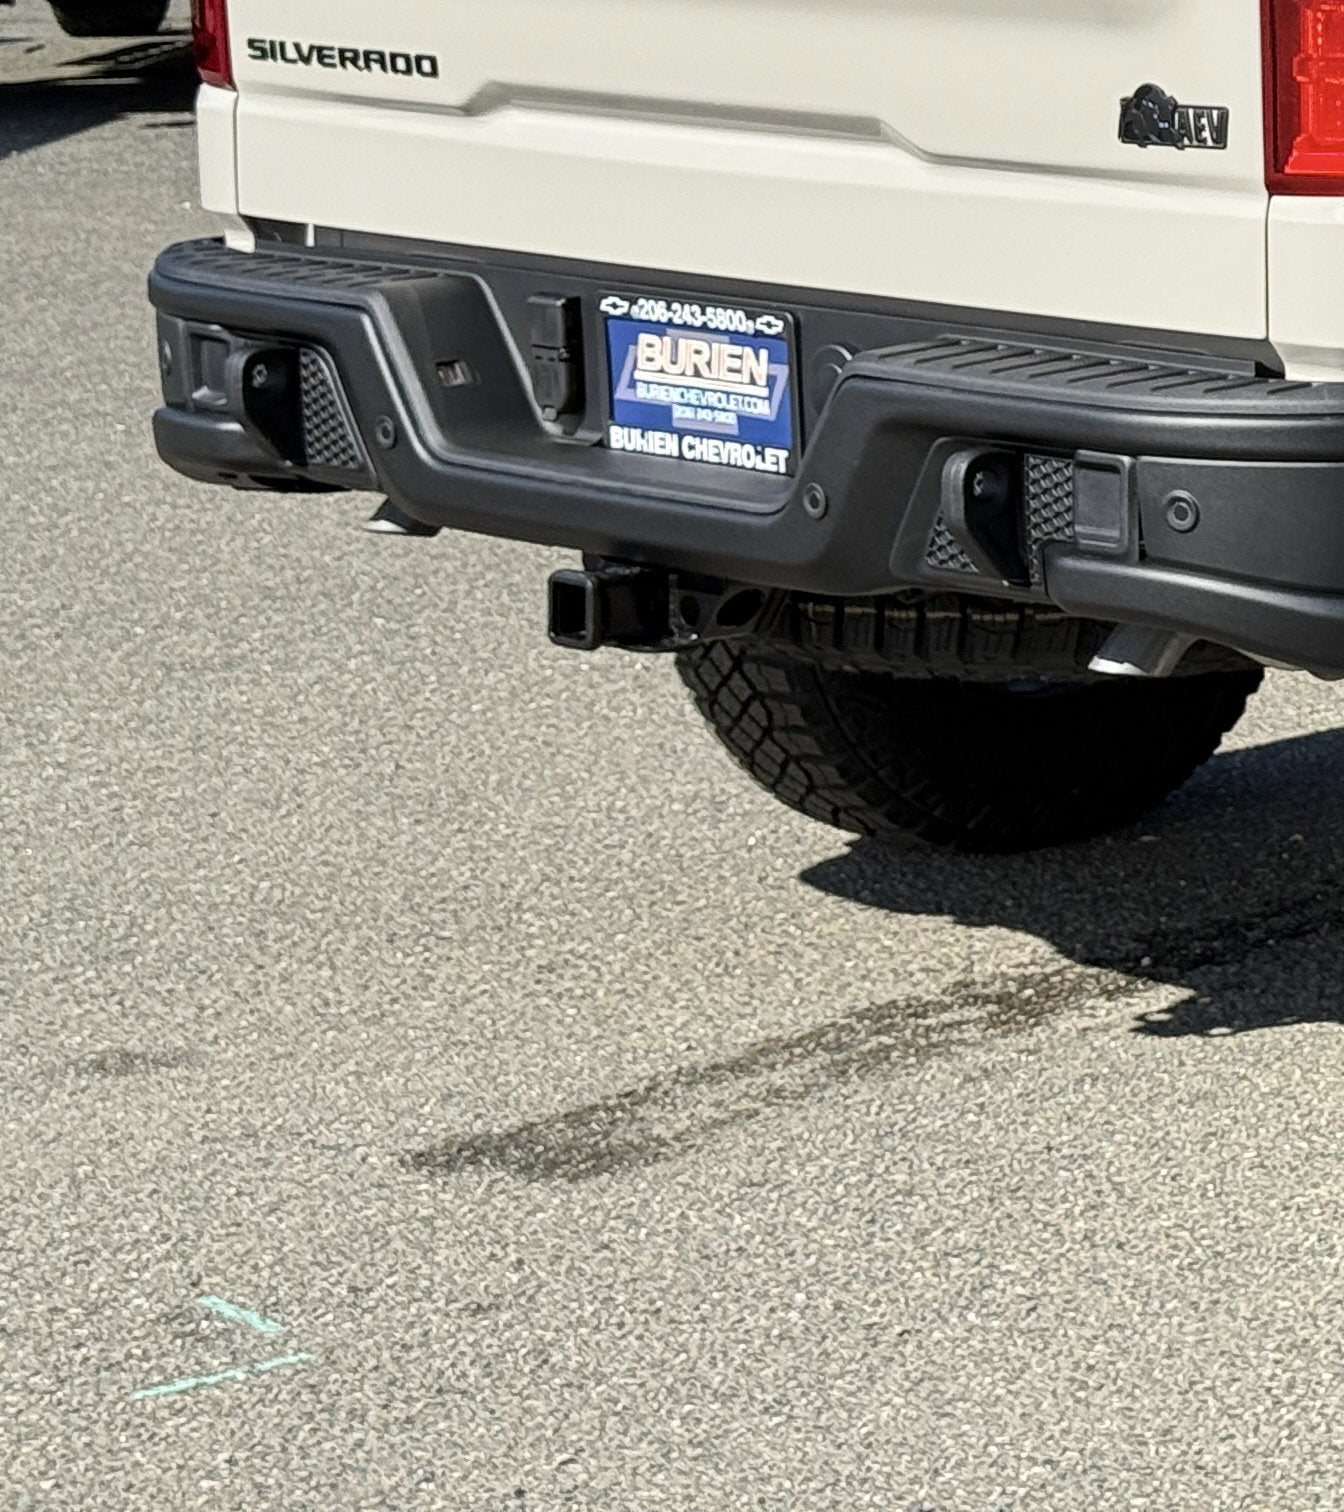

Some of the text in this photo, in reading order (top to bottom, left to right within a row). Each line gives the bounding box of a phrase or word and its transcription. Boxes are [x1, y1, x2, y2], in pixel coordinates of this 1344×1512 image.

[247, 38, 439, 79] SILVERADO
[636, 332, 769, 387] BURIEN
[609, 425, 788, 473] BURIEN CHEVROLET
